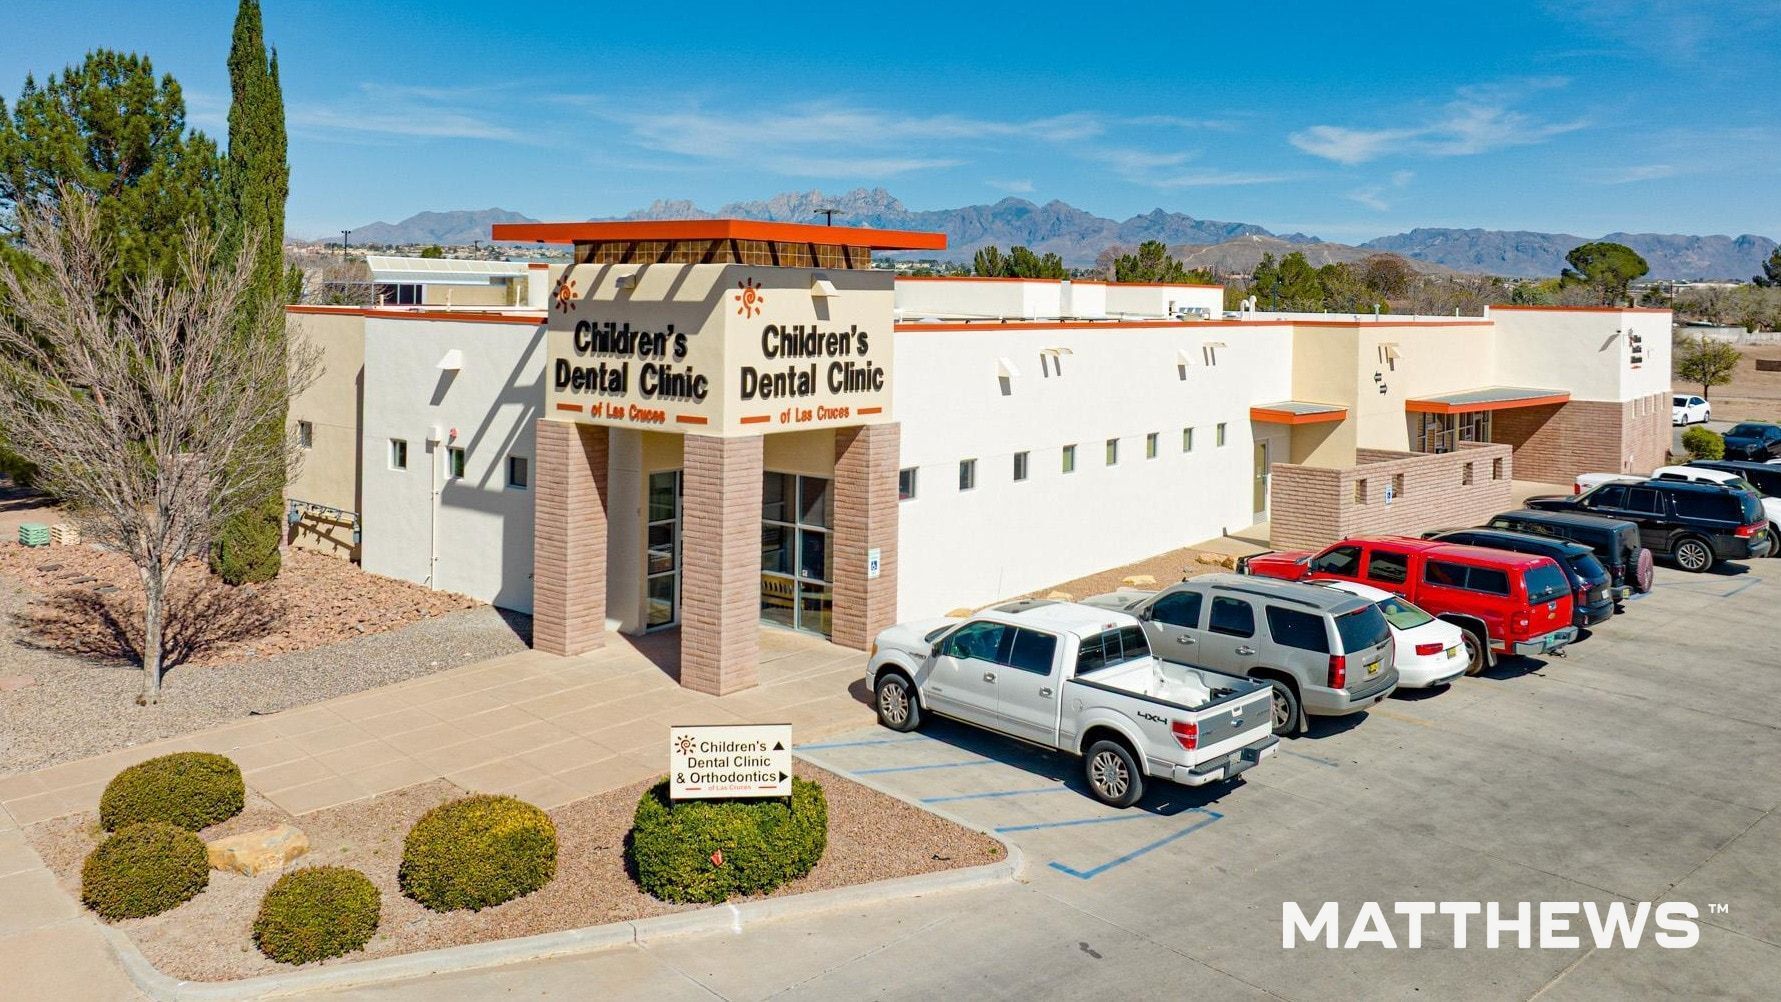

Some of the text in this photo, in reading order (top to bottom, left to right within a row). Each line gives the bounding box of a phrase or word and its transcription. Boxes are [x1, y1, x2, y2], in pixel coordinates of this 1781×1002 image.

[574, 319, 689, 359] Children's
[761, 323, 869, 359] Children's
[555, 357, 709, 400] Dental Clinic
[740, 360, 884, 400] Dental Clinic
[590, 401, 666, 424] of Las Cruces
[779, 405, 850, 424] of Las Cruces
[700, 740, 767, 753] Children's
[688, 755, 771, 769] Dental Clinic
[676, 770, 777, 784] & Orthodontics
